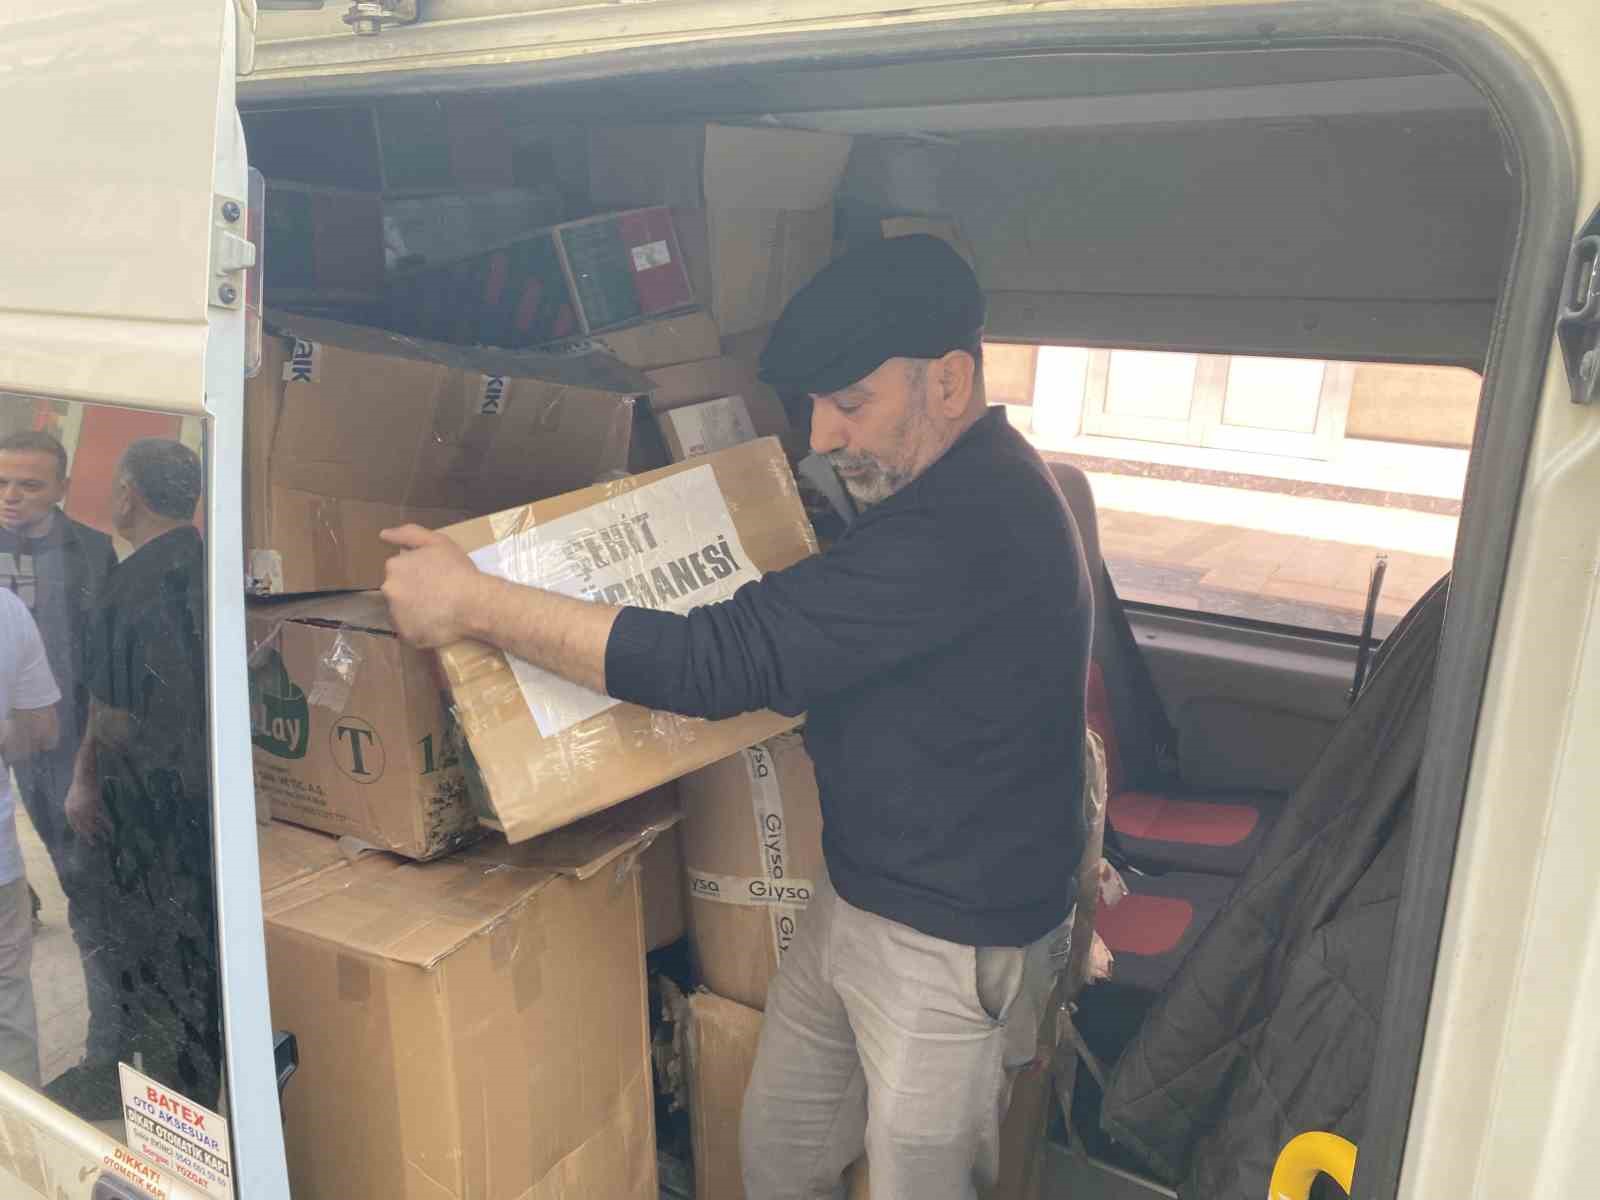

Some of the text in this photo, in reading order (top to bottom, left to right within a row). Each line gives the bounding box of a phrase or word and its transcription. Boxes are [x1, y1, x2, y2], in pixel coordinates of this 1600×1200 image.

[337, 726, 375, 775] T
[133, 1096, 155, 1115] OTO
[146, 1086, 206, 1131] BATEX
[158, 1110, 220, 1151] AKSESUAR
